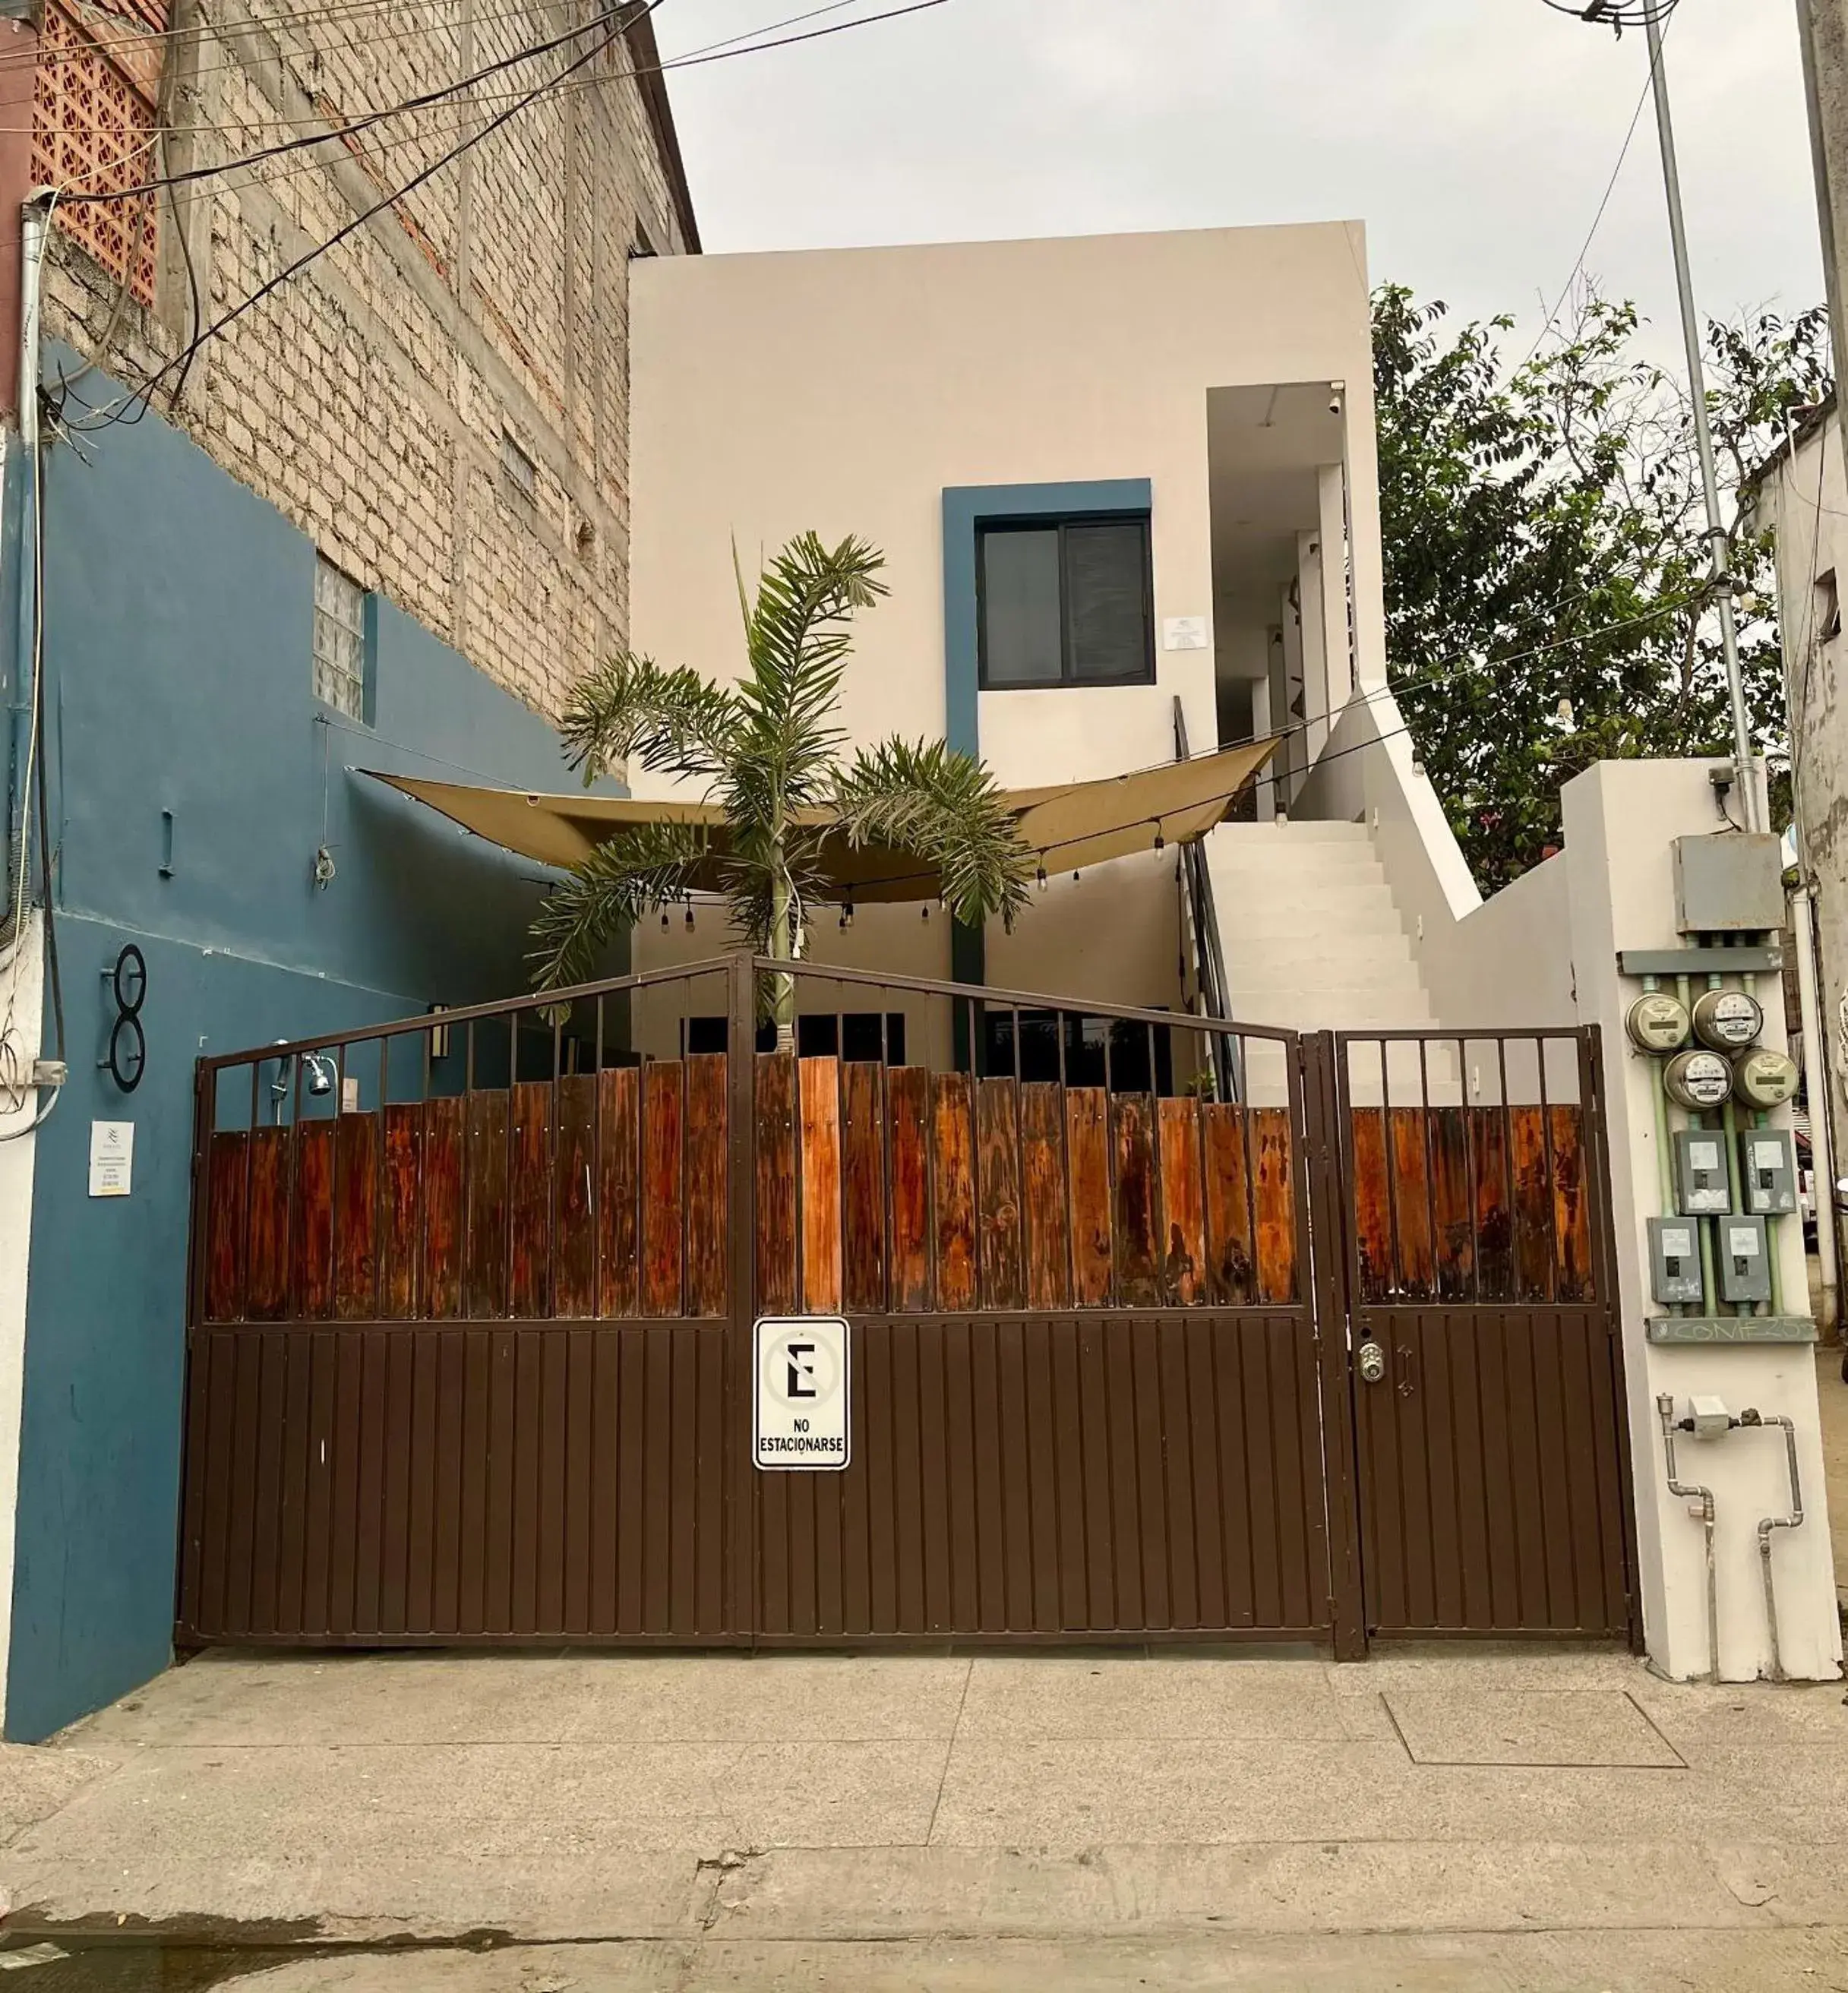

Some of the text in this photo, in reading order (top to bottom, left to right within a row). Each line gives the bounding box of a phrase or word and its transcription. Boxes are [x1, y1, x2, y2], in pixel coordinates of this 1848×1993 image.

[110, 943, 146, 1094] 8
[787, 1344, 816, 1397] E
[794, 1419, 809, 1432] NO
[760, 1438, 843, 1451] ESTACIONARSE
